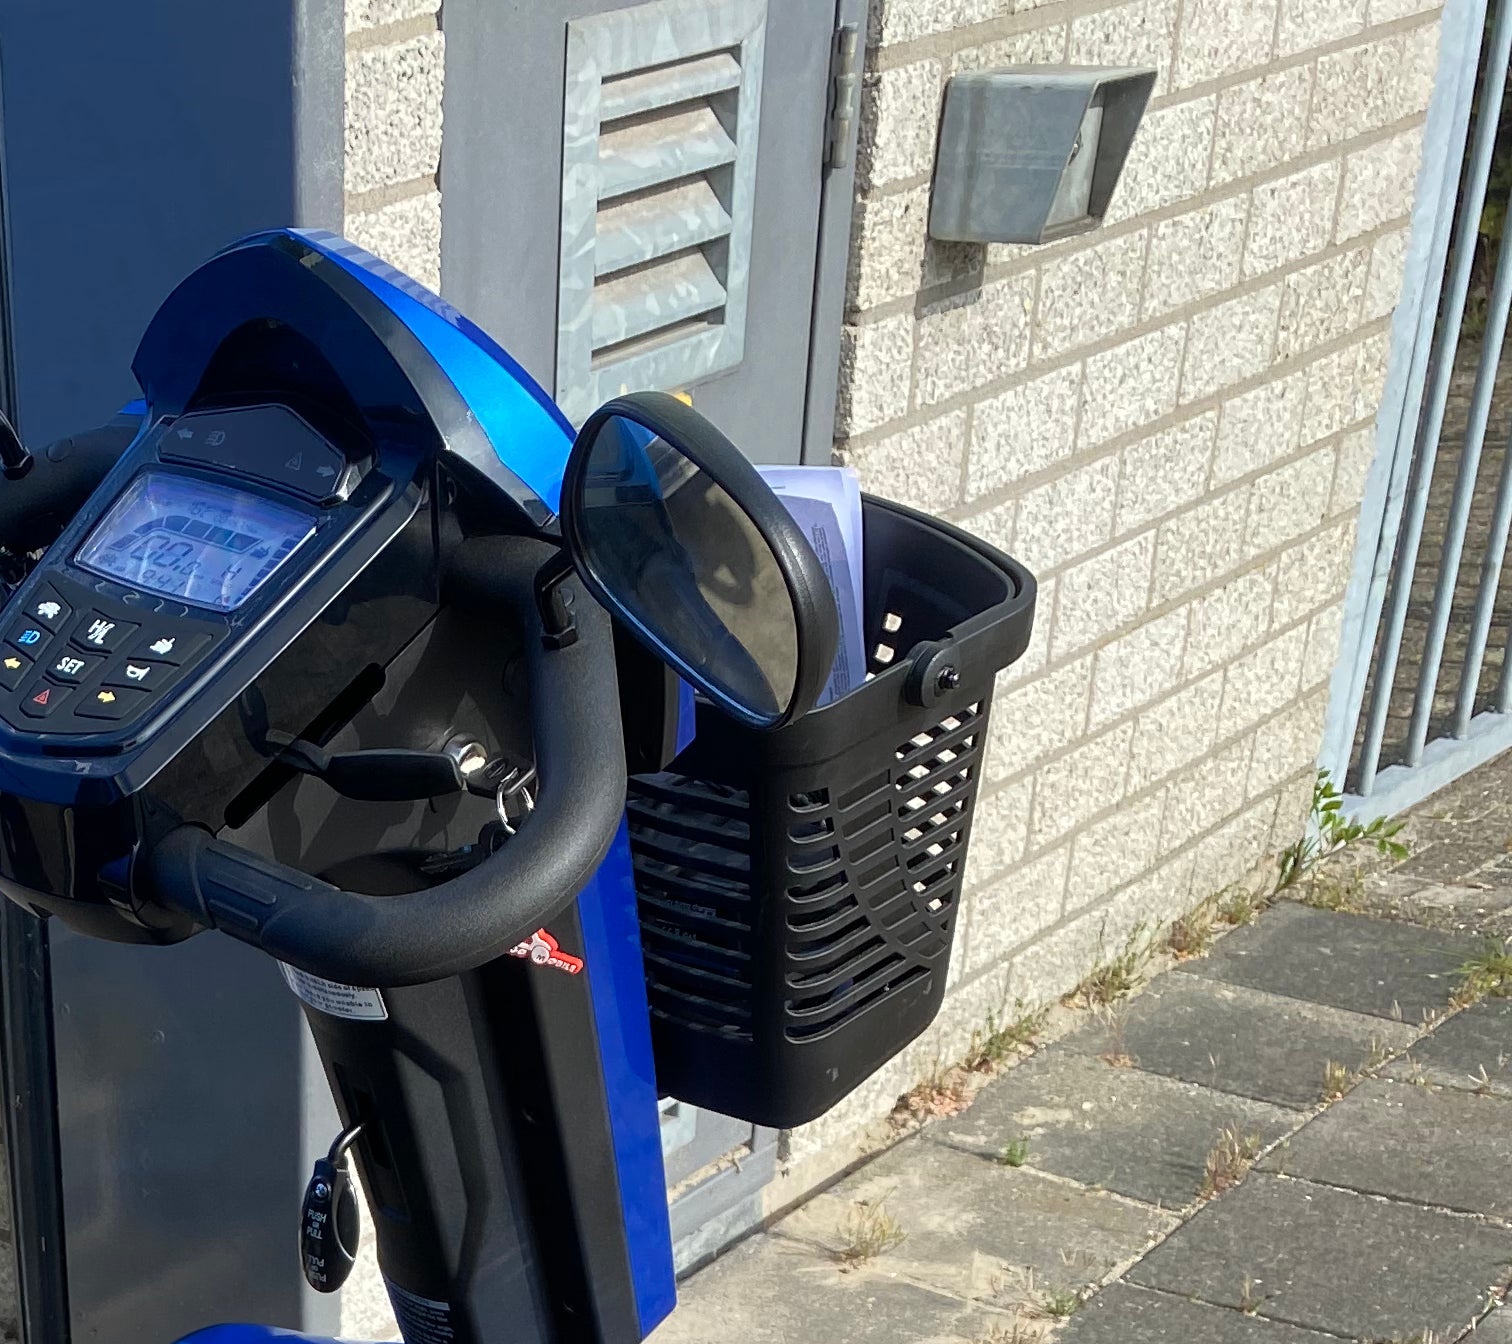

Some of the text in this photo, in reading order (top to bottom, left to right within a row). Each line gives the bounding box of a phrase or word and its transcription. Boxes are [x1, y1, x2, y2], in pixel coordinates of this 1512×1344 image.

[56, 656, 85, 675] SET
[307, 1208, 327, 1224] PUSH
[306, 1226, 323, 1240] PULL
